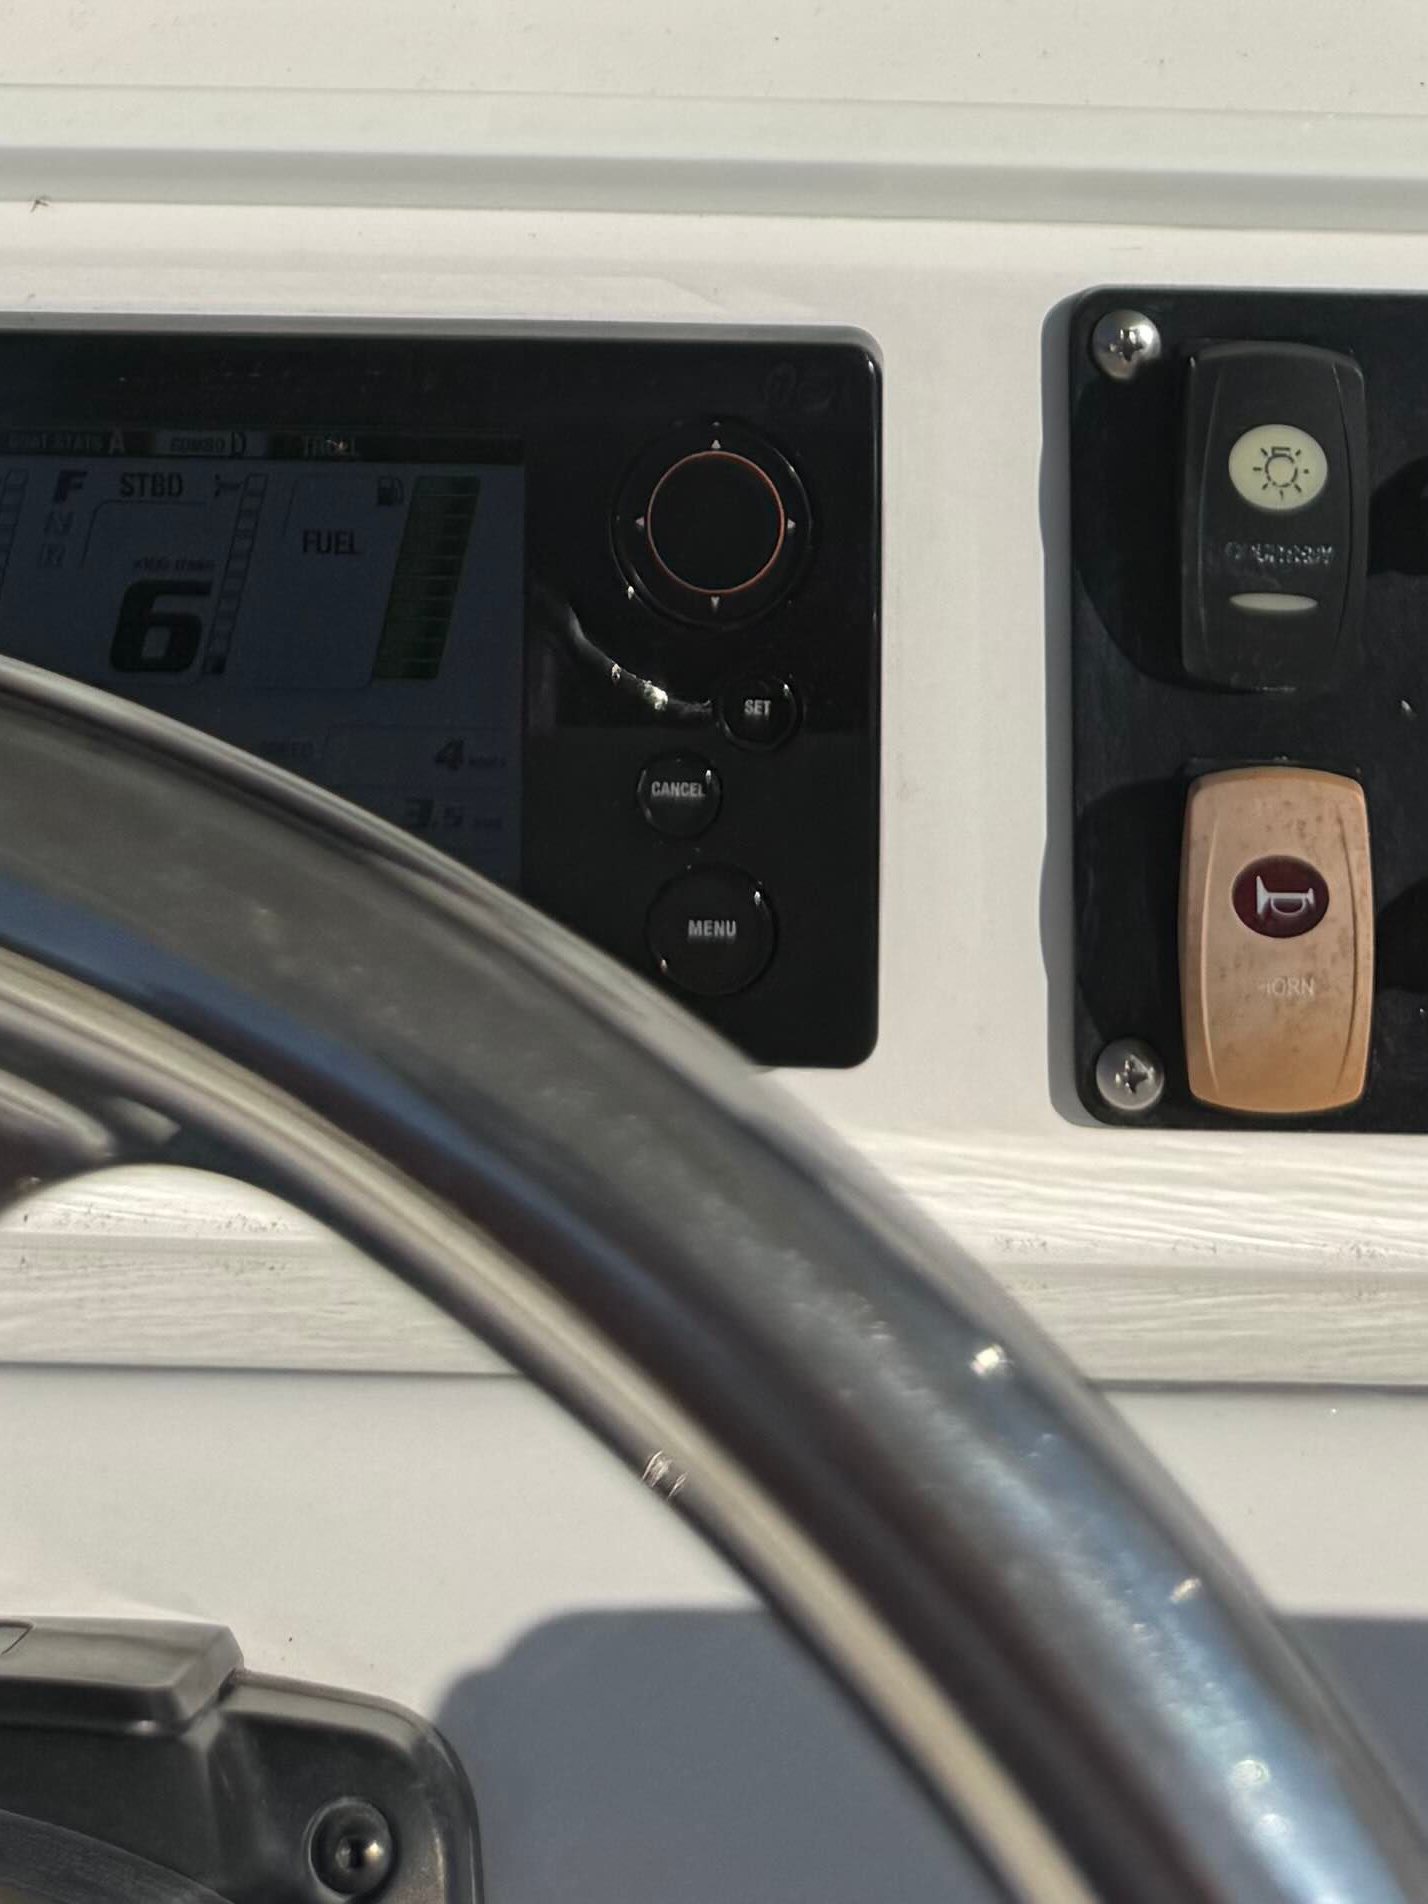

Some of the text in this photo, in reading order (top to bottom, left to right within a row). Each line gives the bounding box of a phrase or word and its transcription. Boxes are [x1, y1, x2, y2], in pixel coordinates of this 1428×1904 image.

[107, 428, 126, 456] A
[53, 469, 88, 504] F
[119, 471, 185, 498] STBD
[302, 529, 356, 555] FUEL
[109, 579, 214, 673] 6
[743, 699, 772, 721] SET
[433, 738, 466, 772] 4
[649, 780, 708, 799] CANCEL
[687, 919, 738, 938] MENU
